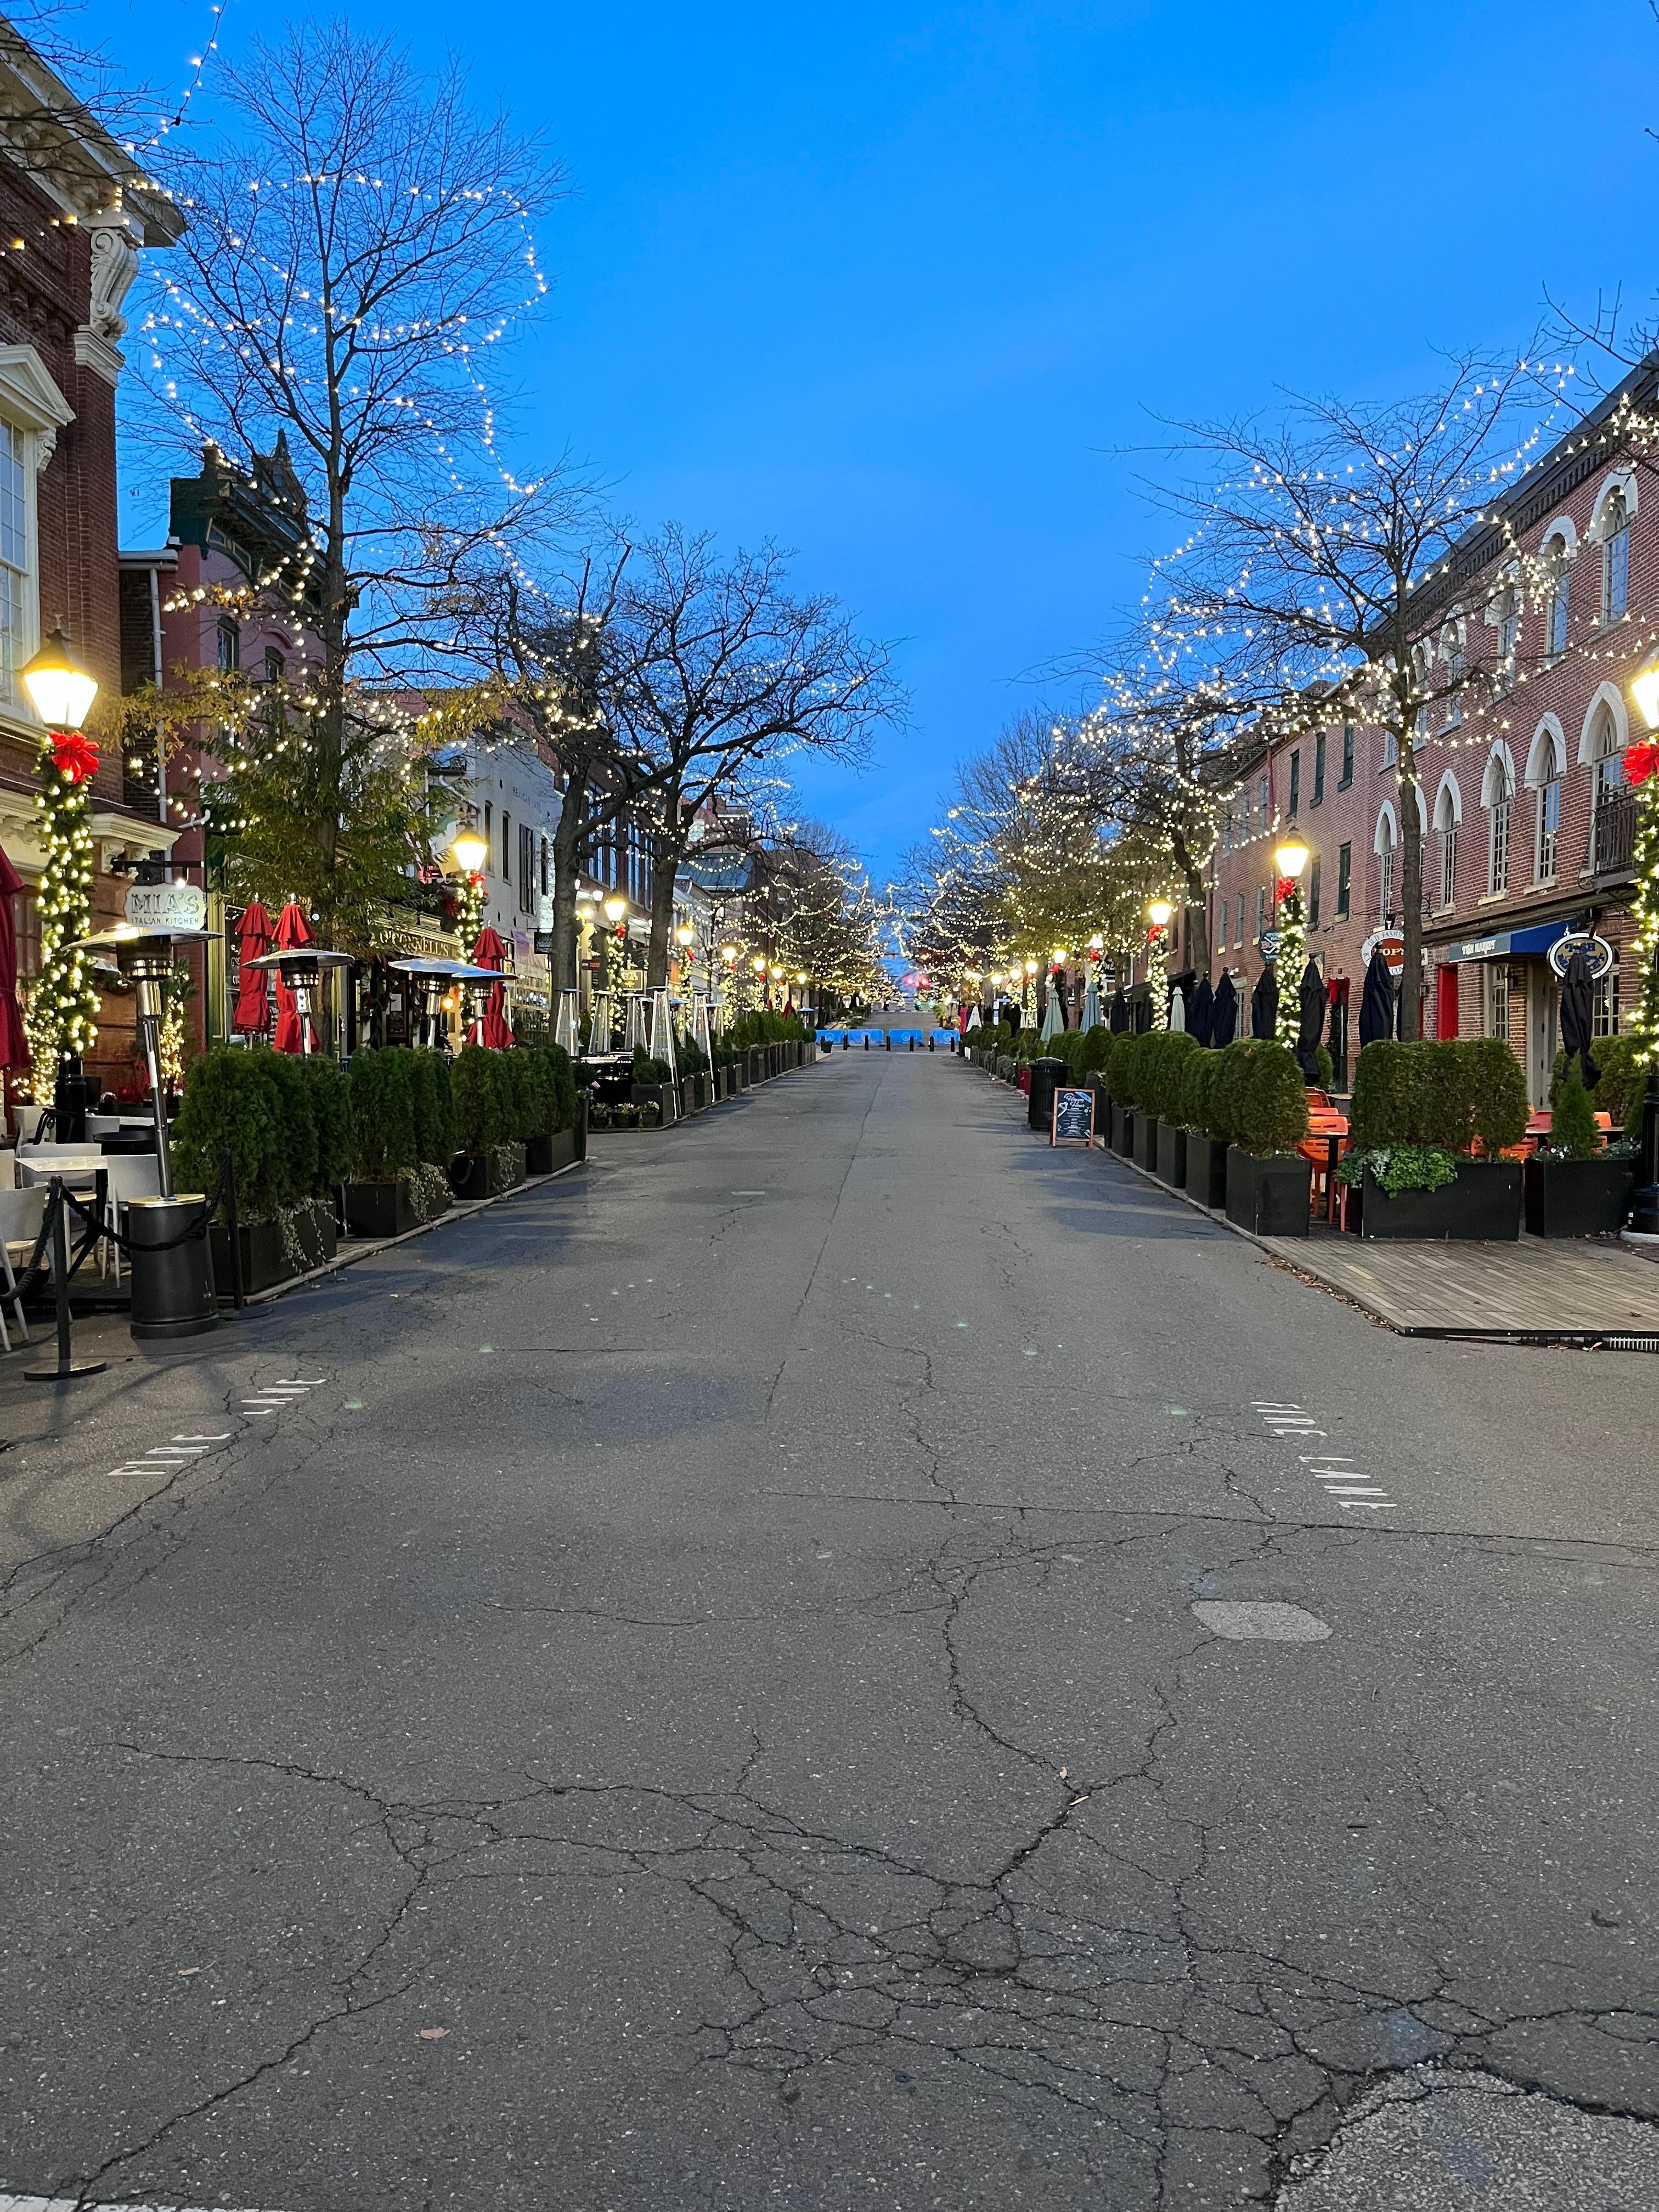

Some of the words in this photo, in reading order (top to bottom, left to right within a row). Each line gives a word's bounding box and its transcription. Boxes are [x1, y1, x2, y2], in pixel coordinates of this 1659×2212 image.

[131, 893, 199, 915] MIA'S
[131, 917, 161, 925] ITALIAN
[1367, 935, 1380, 946] OLD
[107, 1432, 232, 1476] FIRE
[240, 1378, 327, 1415] LANE
[1250, 1401, 1328, 1436] FIRE
[1298, 1455, 1398, 1509] LANE
